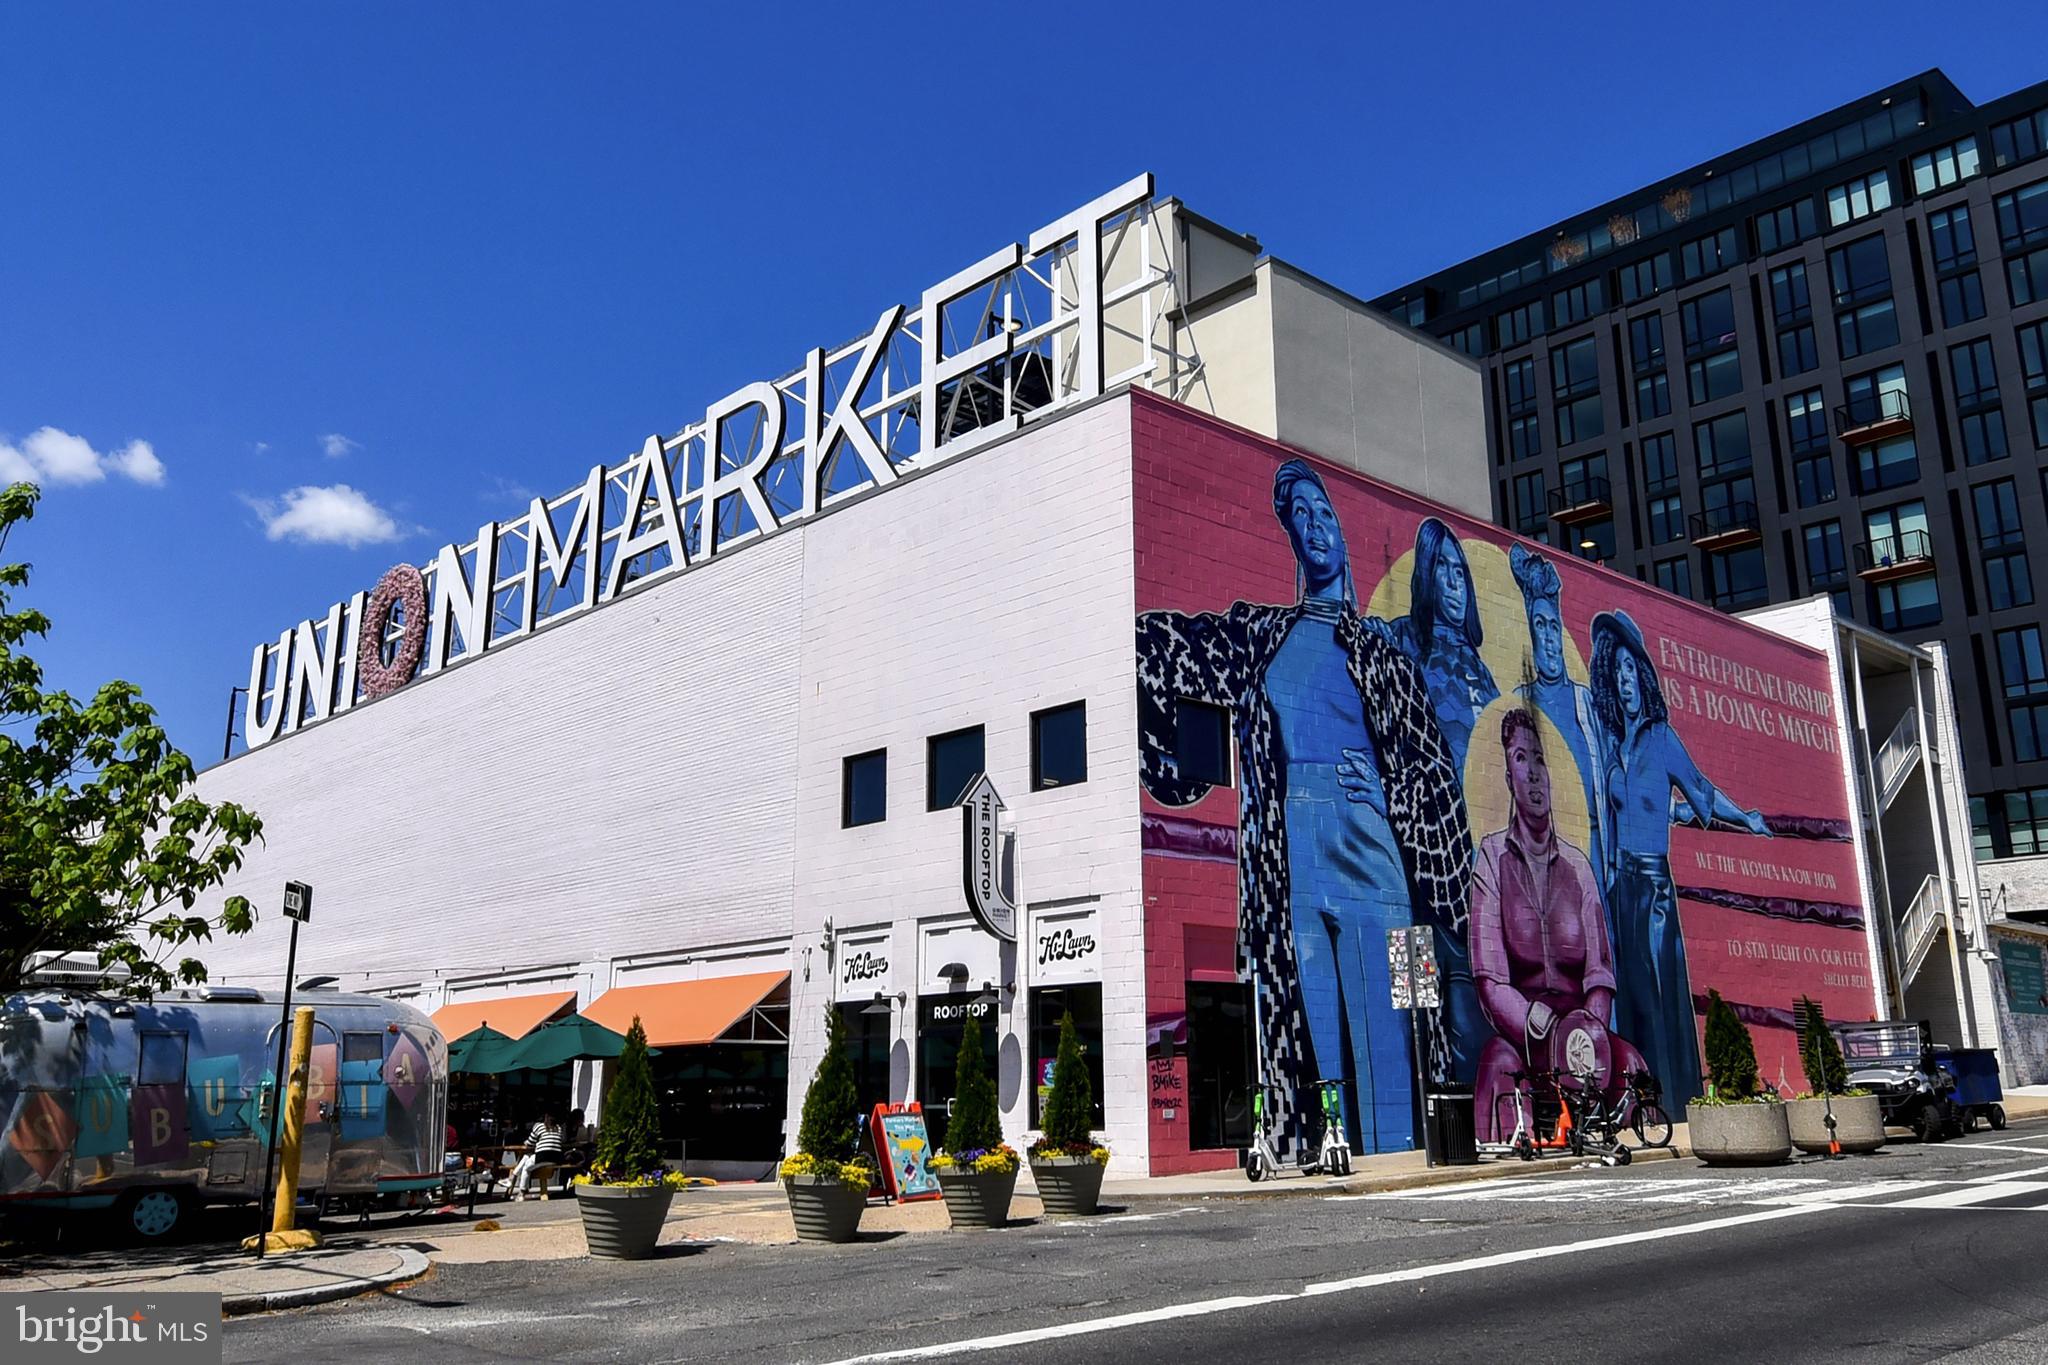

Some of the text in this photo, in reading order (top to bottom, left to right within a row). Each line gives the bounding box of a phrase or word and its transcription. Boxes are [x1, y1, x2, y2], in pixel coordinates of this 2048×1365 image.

[245, 172, 1155, 749] UNION MARKET
[1659, 637, 1832, 717] ENTREPRENEURSHIP
[1662, 677, 1684, 710] IS
[1688, 685, 1701, 715] A
[1704, 690, 1775, 736] BOXING
[981, 793, 991, 900] THE ROOFTOP
[1696, 852, 1714, 870] WE
[1717, 855, 1737, 874] THE
[1740, 859, 1780, 881] WOMEN
[1039, 928, 1095, 965] Hi-Lawn
[1727, 939, 1742, 957] TO
[1745, 941, 1769, 960] STAY
[1771, 944, 1801, 962] LIGHT
[844, 951, 888, 983] Hi-Lawn
[933, 1003, 988, 1020] ROOFTOP
